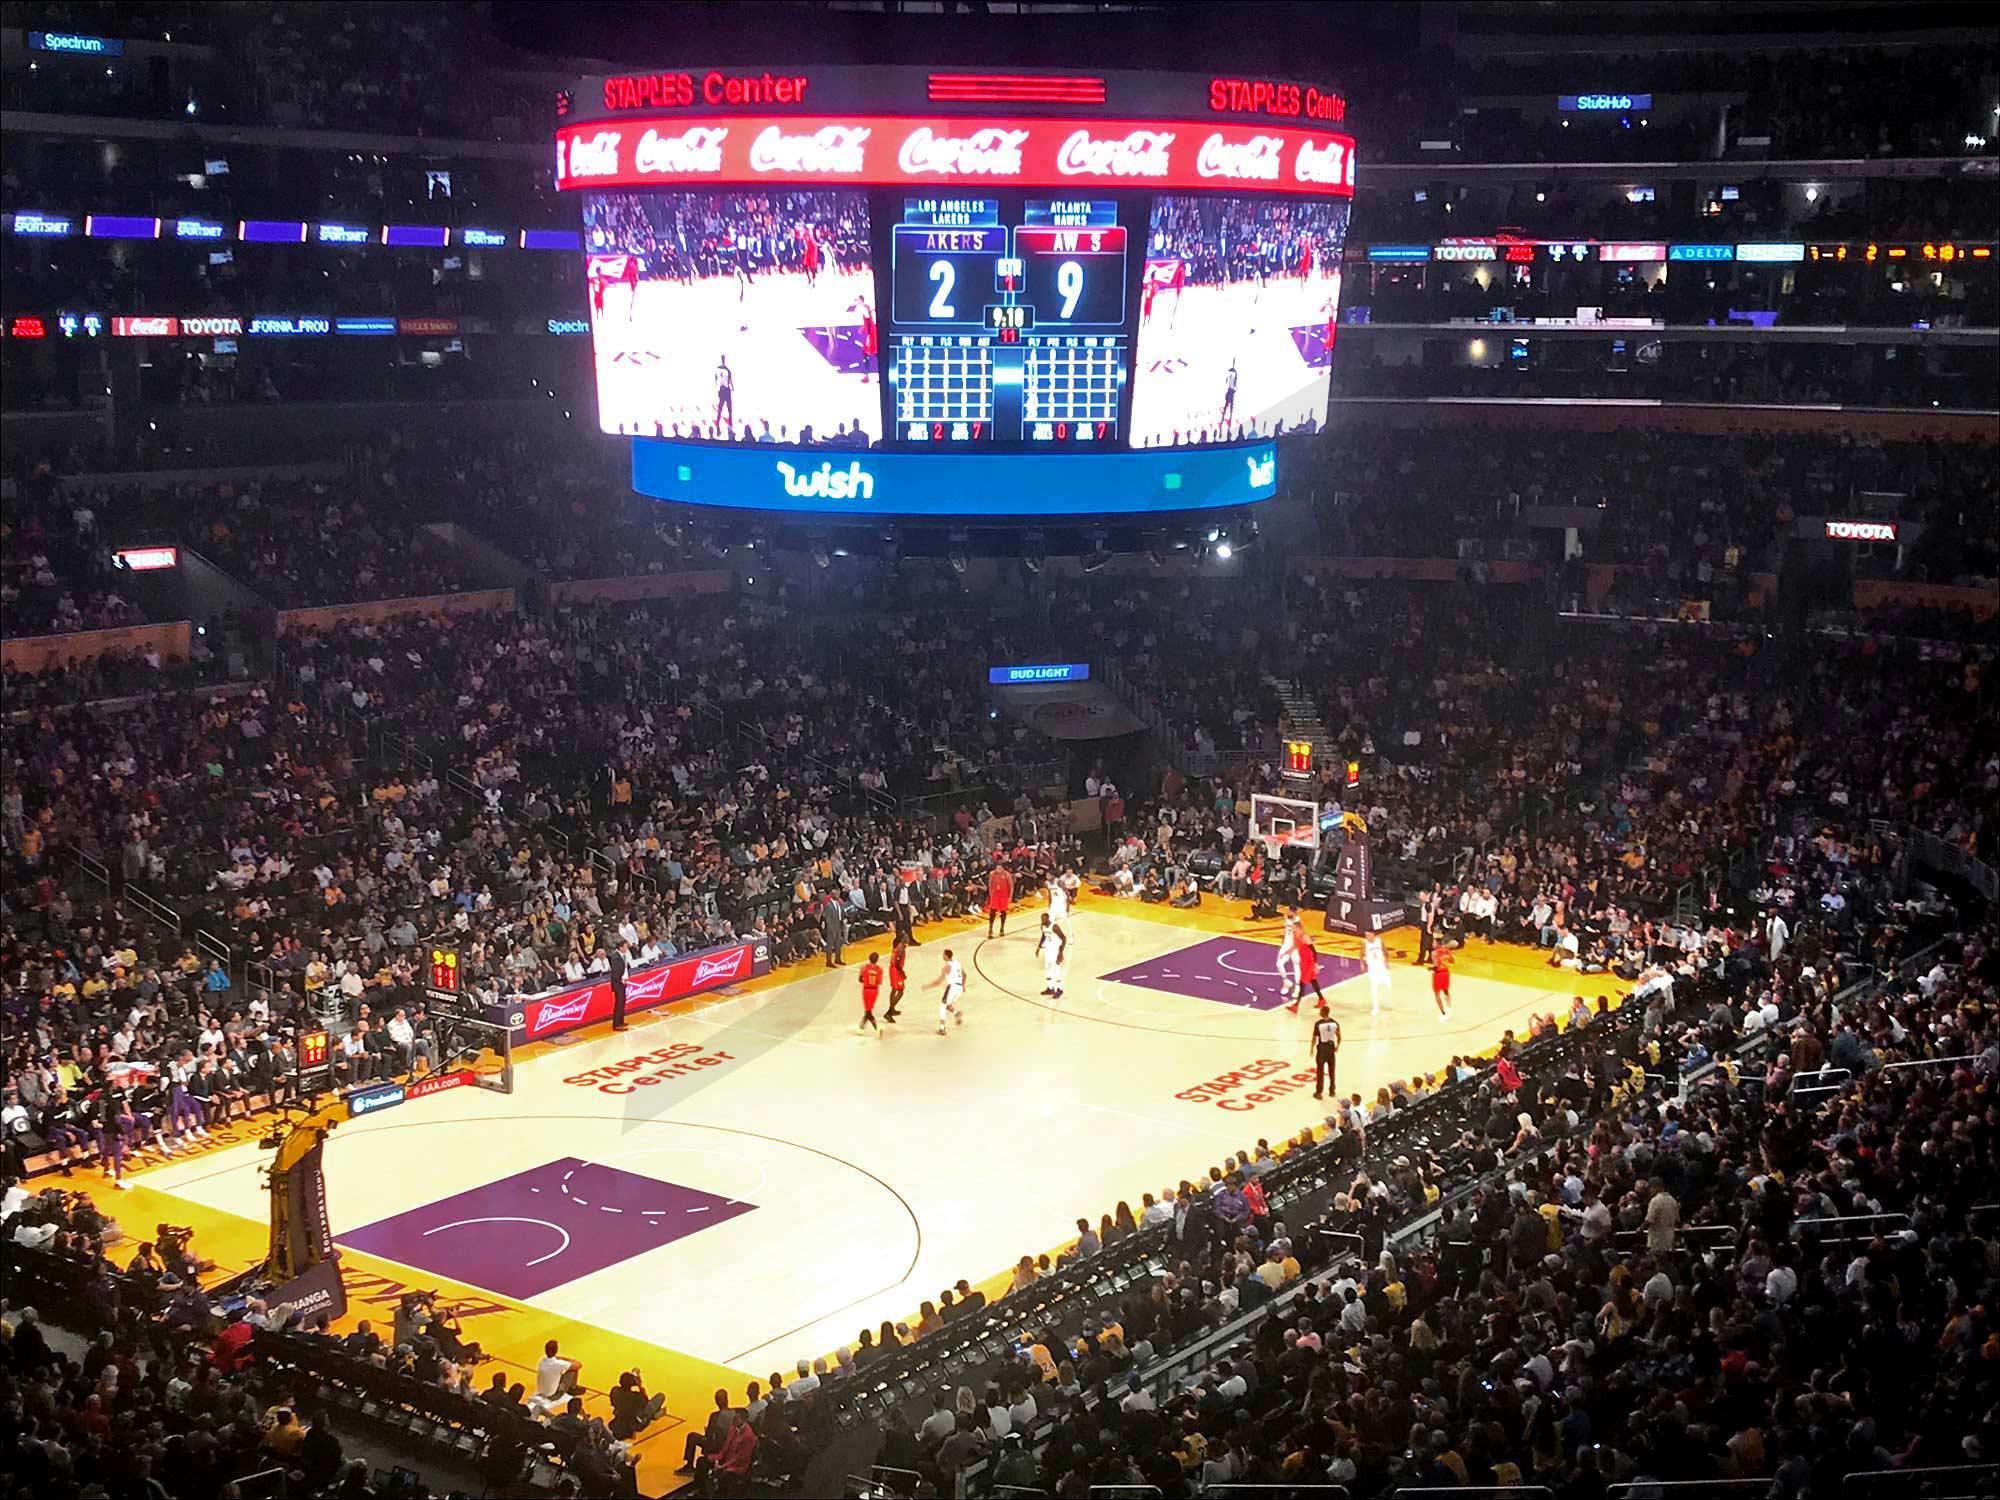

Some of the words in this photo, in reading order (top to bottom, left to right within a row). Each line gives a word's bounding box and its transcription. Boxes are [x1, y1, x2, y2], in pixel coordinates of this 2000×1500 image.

[45, 34, 102, 50] Spectrum
[604, 74, 695, 110] STAPLES
[703, 71, 808, 105] Center
[1209, 78, 1300, 116] STAPLES
[1305, 86, 1346, 122] Center
[1577, 96, 1632, 109] StubHub
[918, 200, 937, 212] LOS
[940, 201, 985, 213] ANGELES
[1051, 202, 1091, 214] ATLANTA
[932, 213, 970, 225] LAKERS
[1434, 247, 1497, 260] TOYOTA
[1686, 248, 1733, 258] DELTA
[929, 260, 955, 318] 2
[1057, 261, 1084, 319] 9
[180, 319, 243, 335] TOYOTA
[1001, 329, 1017, 343] 11
[933, 422, 944, 439] 2
[973, 423, 982, 440] 7
[1057, 423, 1066, 439] 0
[1097, 423, 1106, 440] 7
[776, 459, 874, 499] wish
[1826, 522, 1895, 540] TOYOTA
[1010, 669, 1035, 679] BUD
[1035, 668, 1069, 678] LIGHT
[435, 966, 456, 990] 11
[562, 1043, 704, 1087] STAPLES
[598, 1050, 736, 1095] Center
[421, 1076, 461, 1094] AAA.com
[1174, 1059, 1291, 1103] STAPLES
